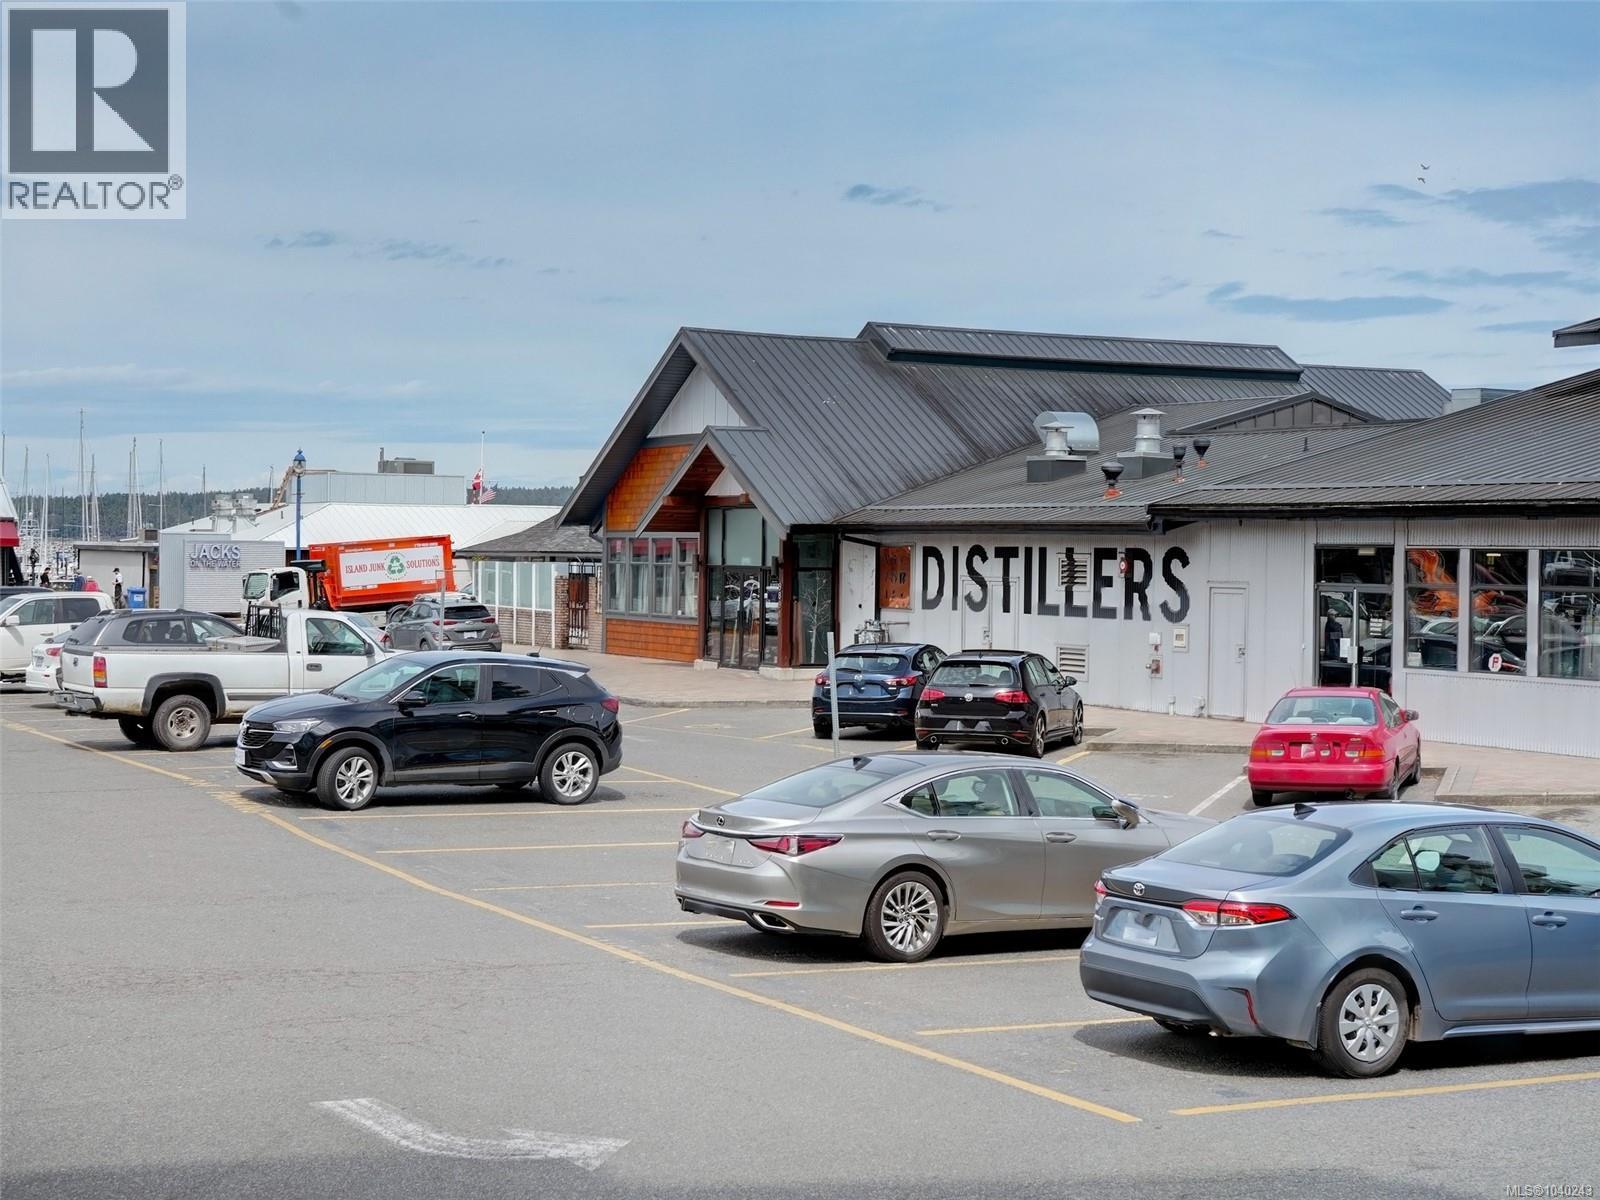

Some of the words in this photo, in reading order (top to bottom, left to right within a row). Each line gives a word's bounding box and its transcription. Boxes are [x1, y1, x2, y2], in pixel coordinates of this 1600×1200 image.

[190, 544, 241, 559] JACKS
[190, 560, 199, 568] ON
[201, 560, 216, 568] THE
[217, 560, 241, 569] WATER
[345, 563, 368, 574] ISLAND
[369, 562, 386, 572] JUNK
[406, 558, 440, 569] SOLUTIONS
[921, 544, 1191, 624] DISTILLERS
